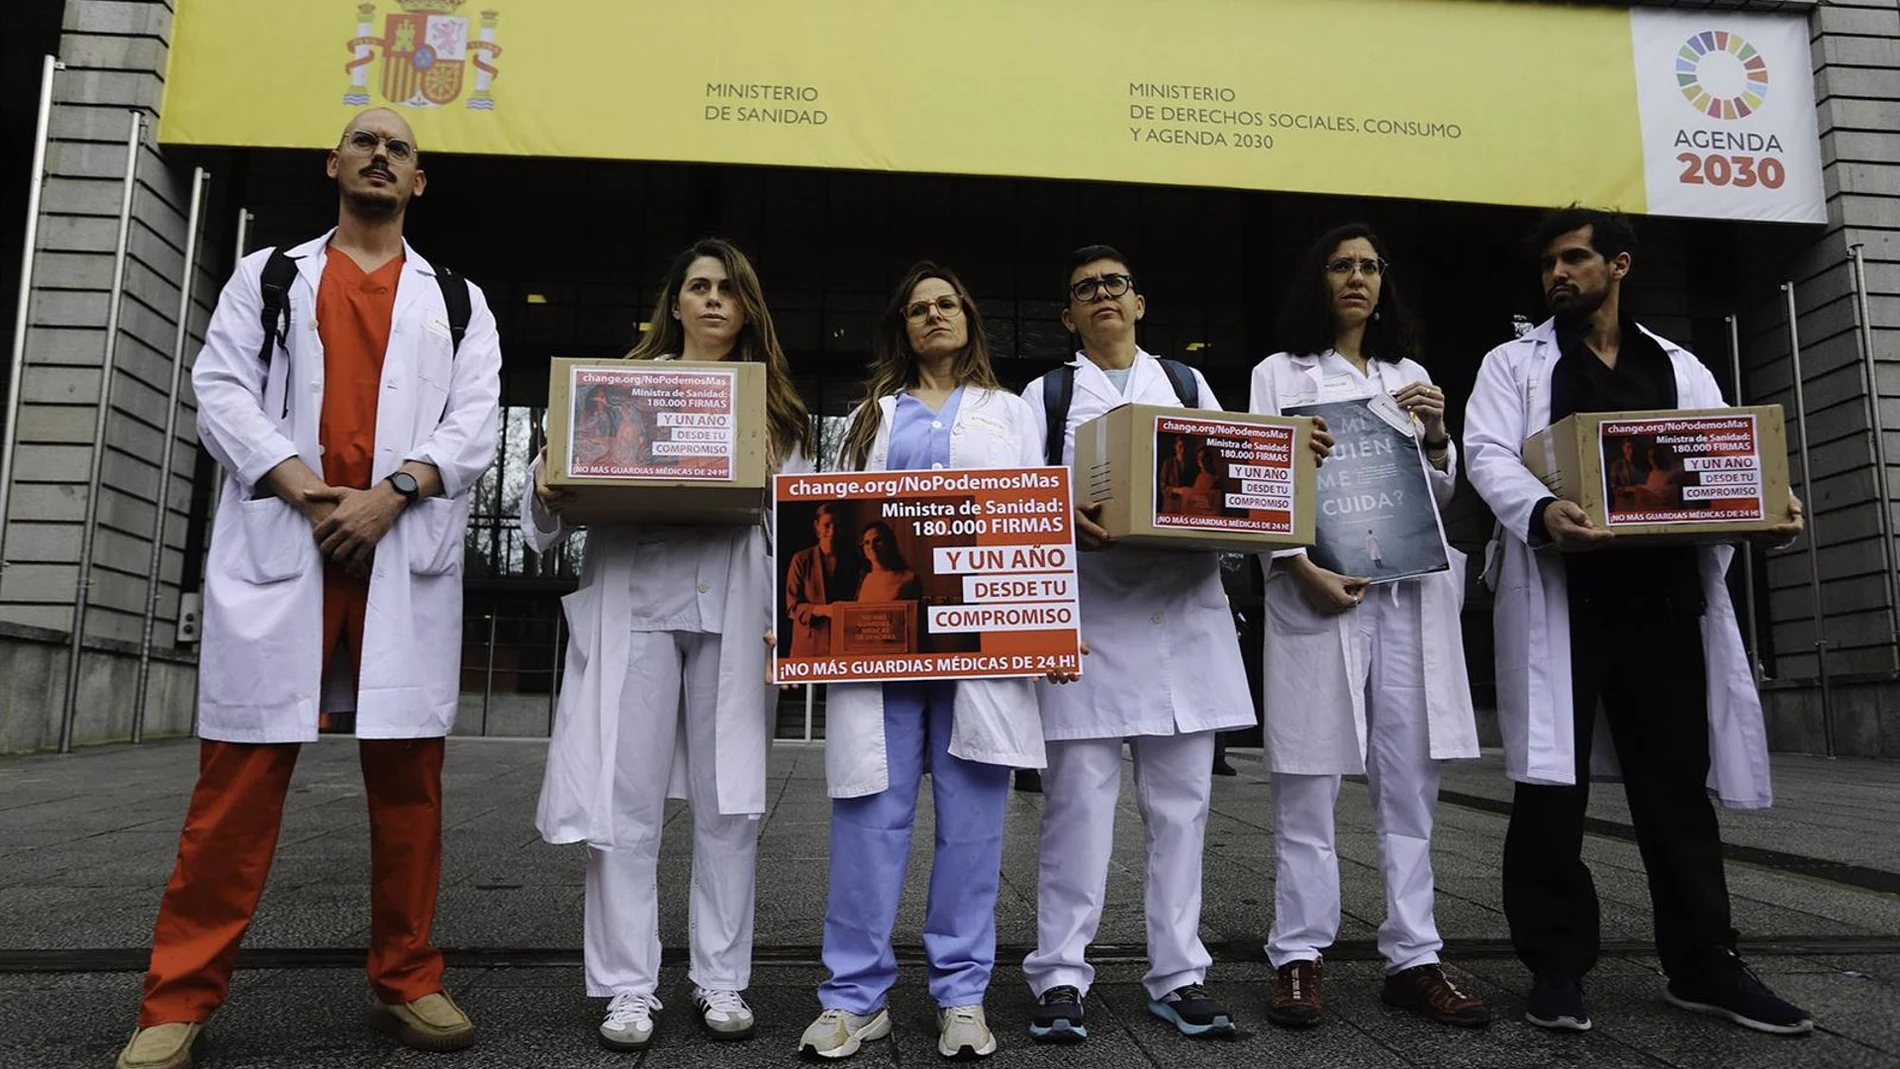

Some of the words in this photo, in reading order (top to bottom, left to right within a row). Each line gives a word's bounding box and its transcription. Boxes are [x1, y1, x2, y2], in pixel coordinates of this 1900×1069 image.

[705, 83, 818, 102] MINISTERIO
[1129, 82, 1236, 102] MINISTERIO
[705, 106, 731, 121] DE
[737, 107, 828, 125] SANIDAD
[1129, 104, 1155, 121] DE
[1160, 107, 1262, 127] DERECHOS
[1364, 119, 1462, 139] CONSUMO
[1129, 127, 1141, 142] Y
[1142, 128, 1228, 147] AGENDA
[1234, 132, 1274, 149] 2030
[1674, 129, 1783, 153] AGENDA
[1676, 152, 1785, 189] 2030
[583, 374, 726, 386] change.org/NoPodemosMas
[632, 388, 671, 397] Ministra
[686, 390, 728, 398] Sanidad:
[647, 399, 686, 407] 180.000
[689, 400, 727, 408] FIRMAS
[664, 415, 674, 424] Y
[676, 416, 696, 425] UN
[1607, 419, 1748, 435] change.org/NoPodemosMas
[677, 431, 711, 439] DESDE
[713, 431, 726, 440] TU
[1163, 422, 1289, 440] change.org/NoPodemosMas
[1656, 435, 1694, 444] Ministra
[1696, 434, 1708, 442] de
[1709, 432, 1750, 442] Sanidad:
[656, 444, 728, 454] COMPROMISO
[1206, 438, 1240, 449] Ministra
[1241, 441, 1252, 449] de
[1253, 441, 1289, 453] Sanidad:
[1323, 436, 1393, 463] UIÉN
[1672, 444, 1711, 453] 180.000
[1713, 442, 1750, 451] FIRMAS
[1220, 450, 1254, 459] 180.000
[1255, 453, 1288, 462] FIRMAS
[1691, 460, 1699, 468] Y
[1702, 459, 1722, 468] UN
[1235, 467, 1243, 477] Y
[1244, 468, 1262, 478] UN
[1317, 470, 1352, 490] ME
[1706, 474, 1739, 483] DESDE
[1741, 473, 1754, 482] TU
[789, 473, 1059, 497] change.org/NoPodemosMas
[1247, 484, 1275, 493] DESDE
[1276, 485, 1288, 494] TU
[1686, 487, 1757, 498] COMPROMISO
[882, 503, 955, 517] Ministra
[959, 500, 982, 515] de
[985, 499, 1064, 514] Sanidad:
[1229, 496, 1289, 508] COMPROMISO
[1322, 490, 1404, 516] CUIDA?
[912, 520, 987, 536] 180.000
[991, 517, 1064, 534] FIRMAS
[946, 551, 961, 570] Y
[968, 550, 1004, 569] UN
[1011, 544, 1065, 568] AÑO
[974, 582, 1037, 598] DESDE
[1040, 580, 1067, 596] TU
[935, 608, 1072, 627] COMPROMISO
[780, 663, 809, 679] ¡NO
[813, 658, 848, 675] MÁS
[851, 659, 933, 673] GUARDIAS
[936, 656, 1007, 672] MÉDICAS
[1011, 656, 1033, 669] DE
[1036, 656, 1056, 668] 24
[1059, 655, 1076, 667] H!
